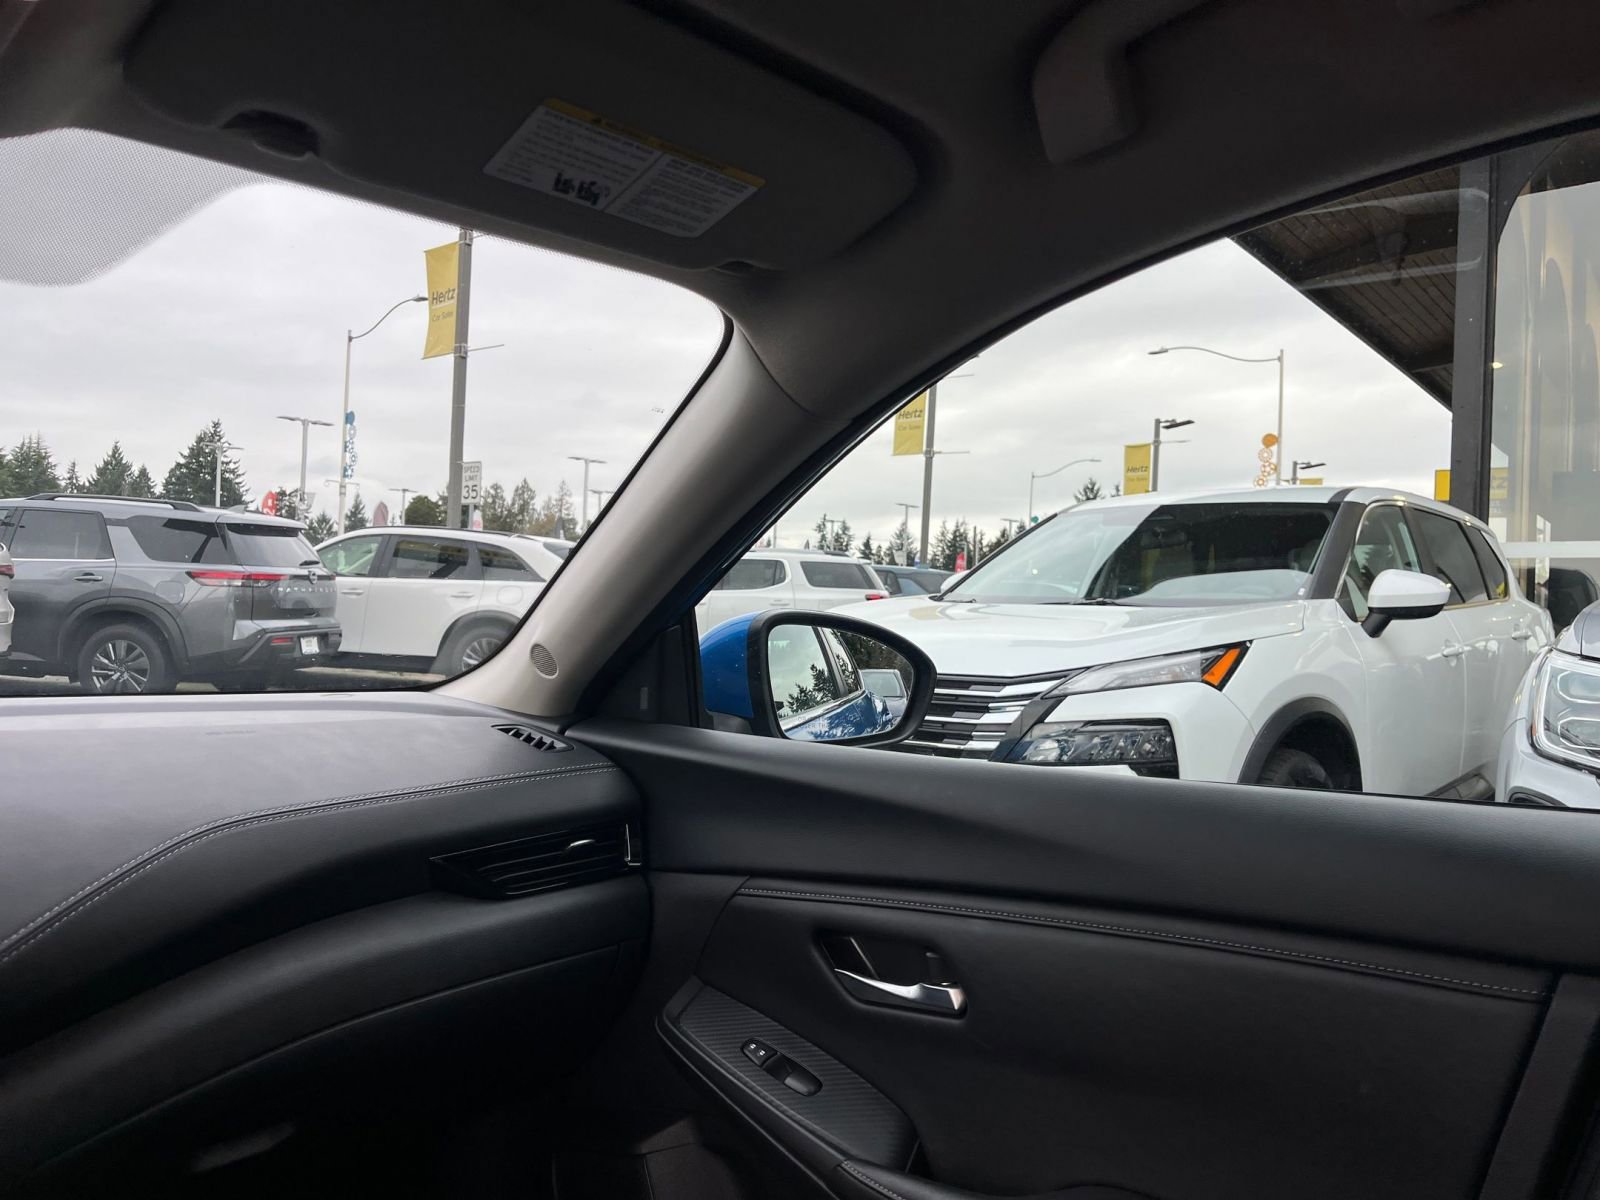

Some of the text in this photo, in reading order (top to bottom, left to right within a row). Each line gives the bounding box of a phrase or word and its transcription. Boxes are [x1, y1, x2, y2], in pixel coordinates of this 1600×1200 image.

[431, 287, 456, 305] Hertz
[898, 408, 922, 420] Hertz
[464, 465, 479, 473] SPEED
[463, 485, 478, 500] 35
